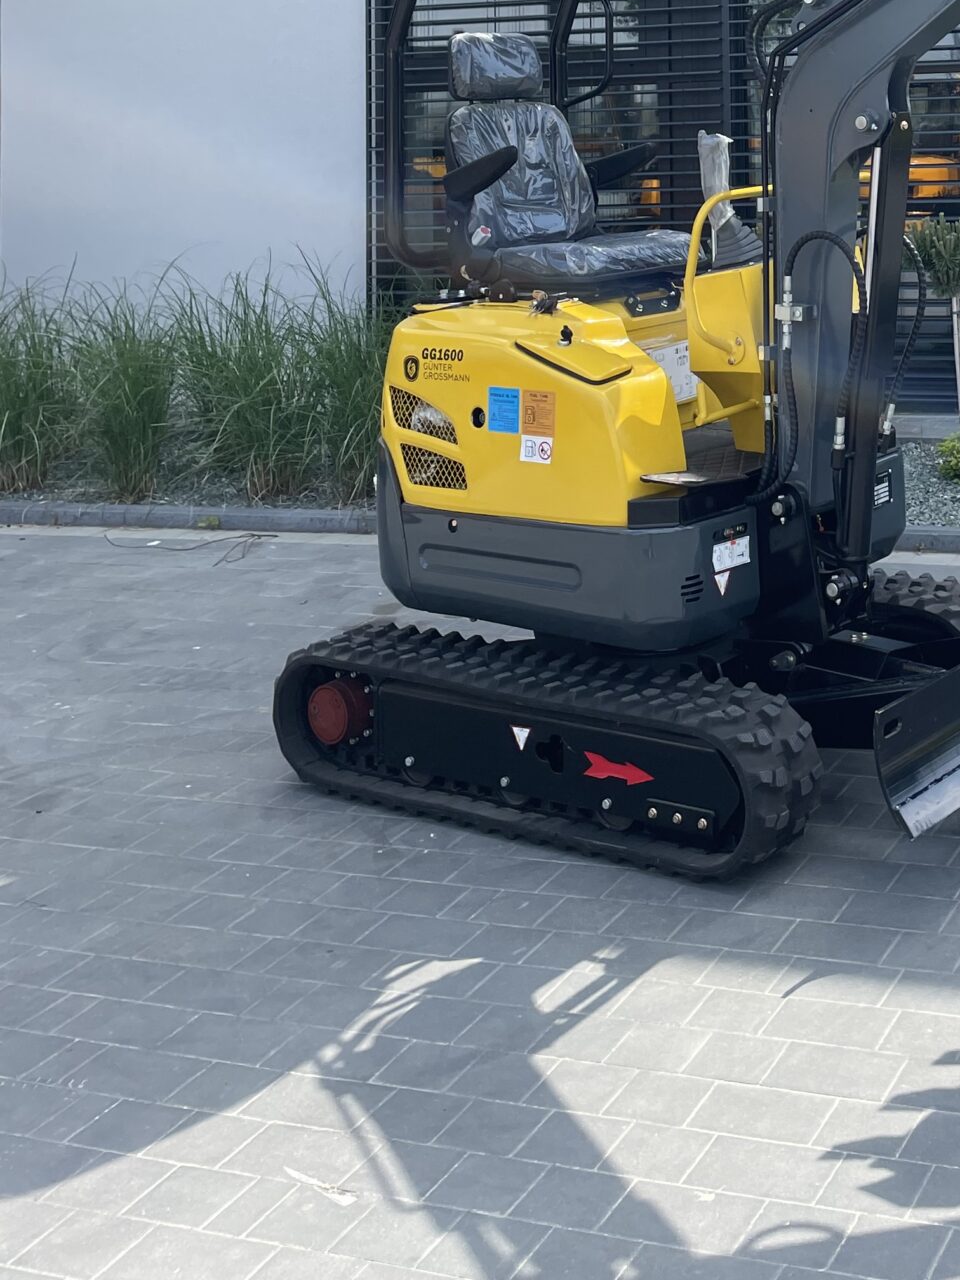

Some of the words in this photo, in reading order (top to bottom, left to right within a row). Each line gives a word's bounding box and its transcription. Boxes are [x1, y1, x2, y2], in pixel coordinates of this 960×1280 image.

[421, 347, 464, 362] GG1600
[423, 361, 453, 372] GÜNTER
[423, 371, 471, 383] GROSSMANN
